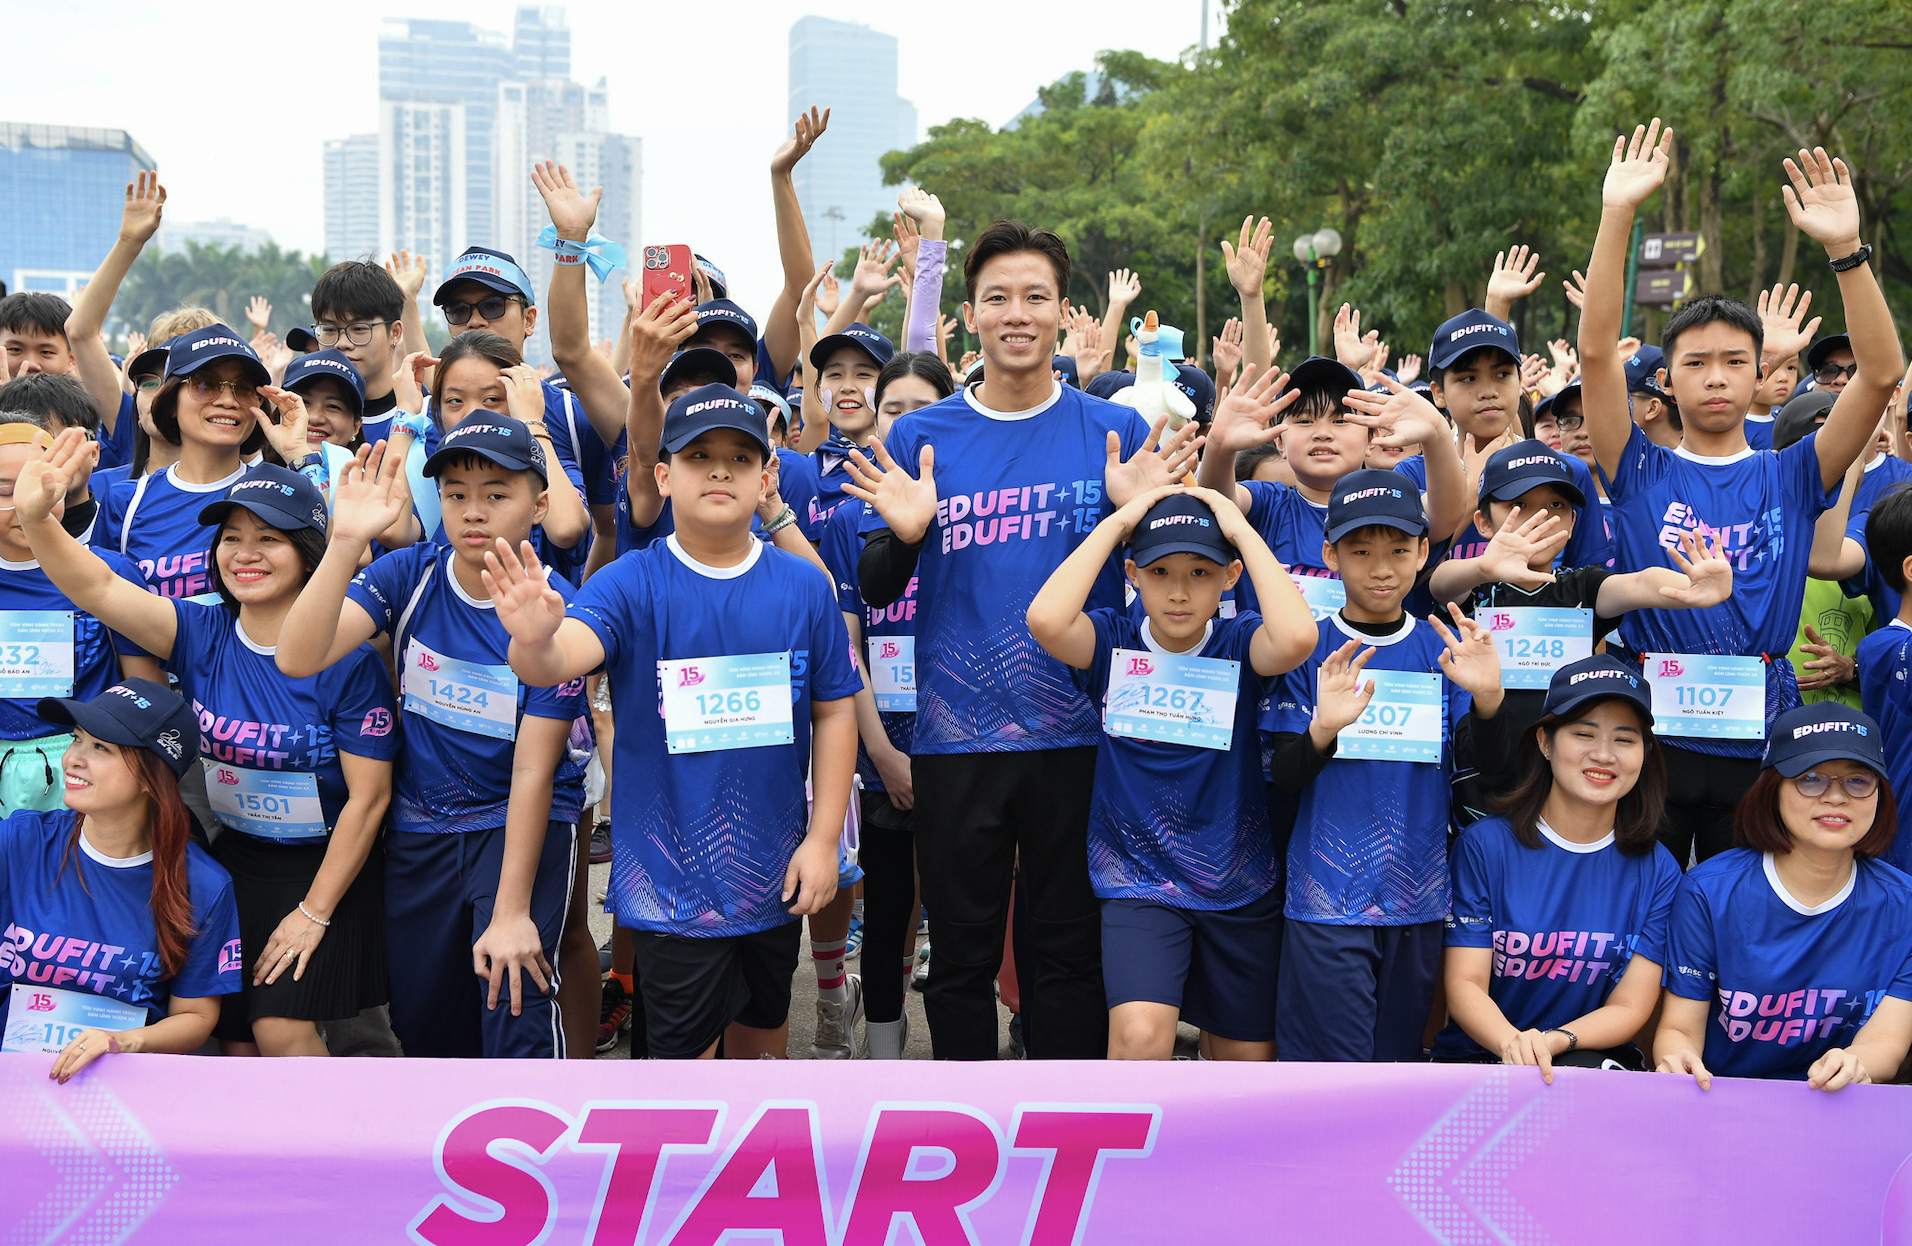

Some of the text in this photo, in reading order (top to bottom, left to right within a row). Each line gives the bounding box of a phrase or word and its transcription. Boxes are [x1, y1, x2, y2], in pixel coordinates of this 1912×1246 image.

[459, 254, 490, 263] DEWEY
[475, 264, 501, 275] PARK
[1494, 614, 1510, 626] 15
[0, 645, 40, 665] 32
[883, 642, 896, 654] 15
[1505, 639, 1564, 658] 1248
[680, 666, 699, 680] 15
[1131, 658, 1149, 671] 15
[1662, 660, 1679, 672] 15
[428, 679, 489, 708] 1424
[696, 690, 761, 716] 1266
[1142, 685, 1205, 712] 1267
[1676, 686, 1733, 707] 1107
[369, 711, 390, 728] 15
[1355, 705, 1412, 727] 307
[200, 734, 290, 769] DUFIT
[235, 793, 290, 814] 1501
[33, 993, 52, 1006] 15
[412, 1102, 1158, 1246] START
